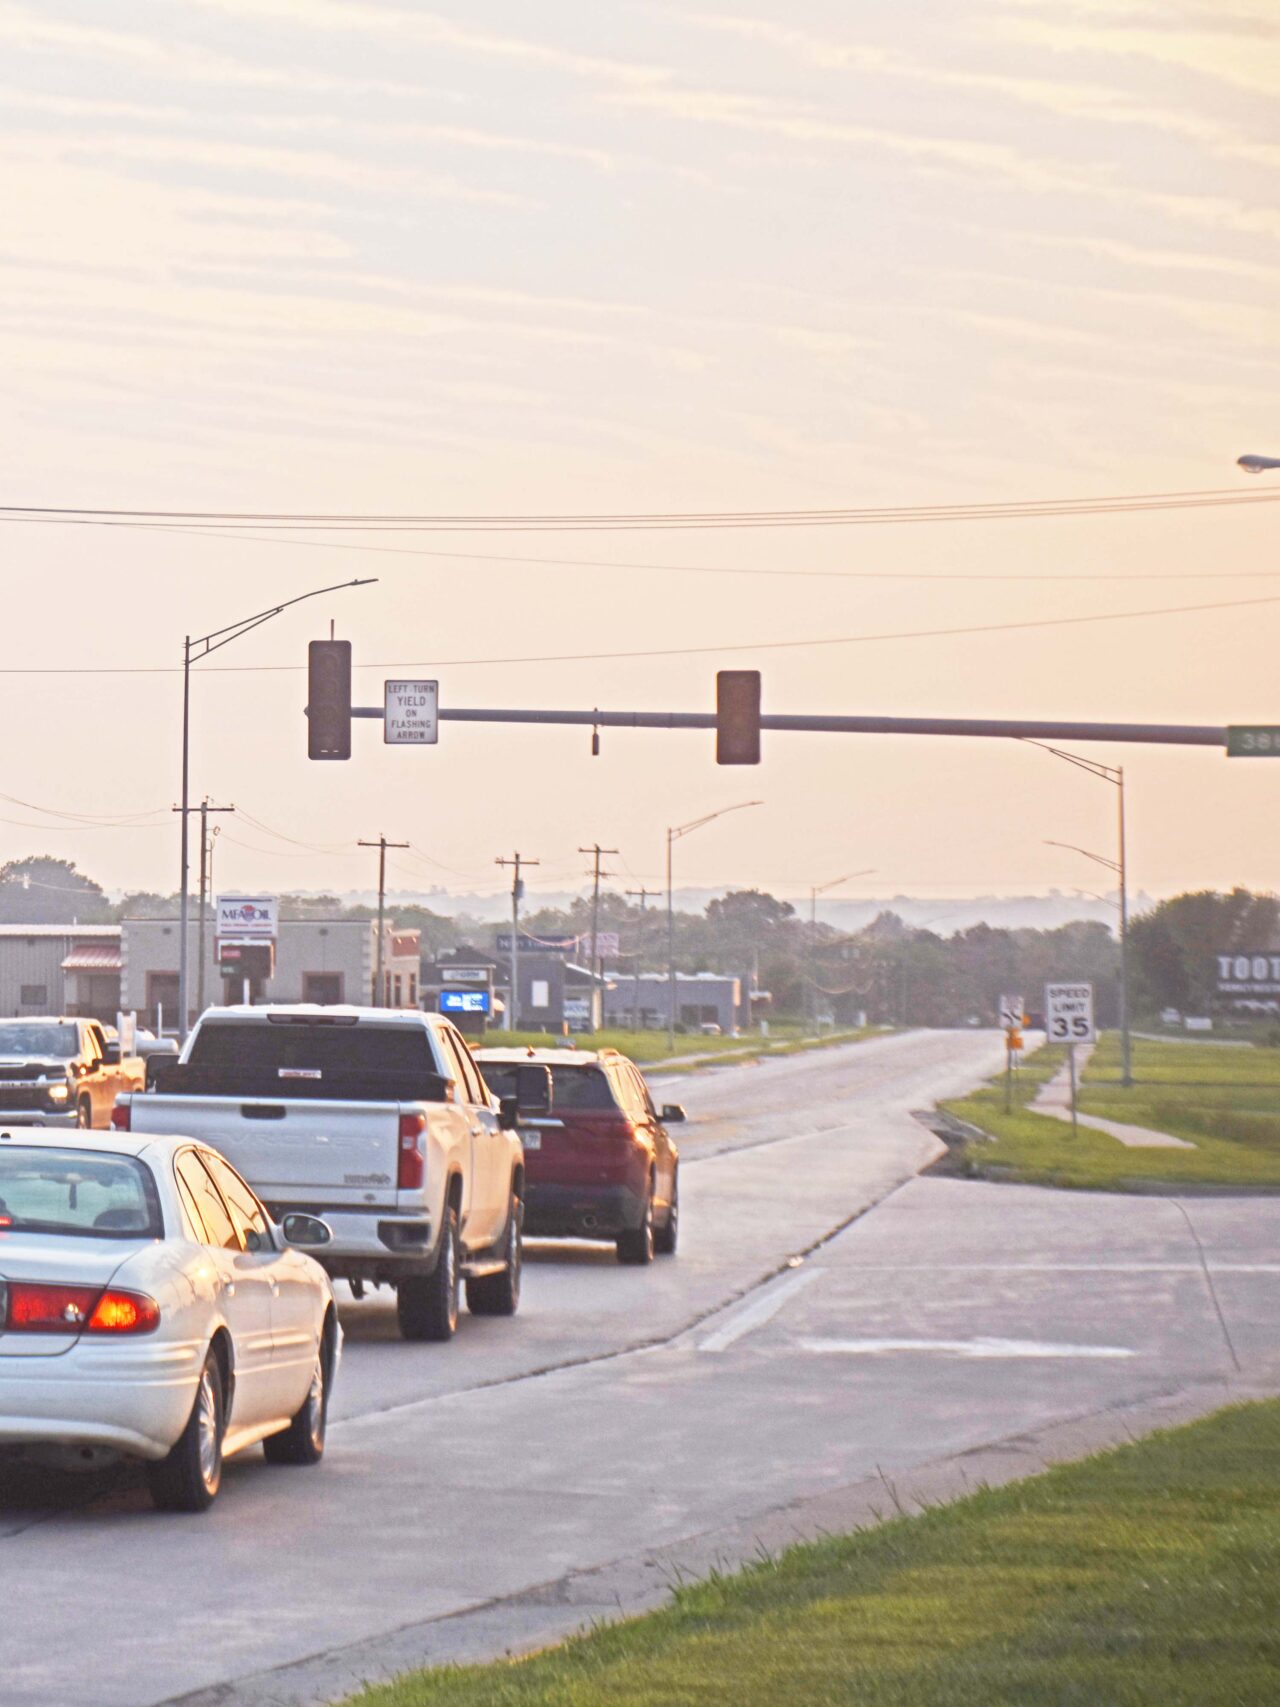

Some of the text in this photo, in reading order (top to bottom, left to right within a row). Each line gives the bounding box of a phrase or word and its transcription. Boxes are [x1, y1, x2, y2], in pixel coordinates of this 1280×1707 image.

[388, 685, 435, 693] LEFT TURN
[397, 696, 426, 706] YIELD
[405, 709, 417, 718] ON
[391, 720, 431, 728] FLASHING
[397, 731, 425, 739] ARROW
[253, 909, 271, 920] OIL
[1217, 955, 1280, 980] TOOT
[1049, 987, 1090, 998] SPEED
[1053, 1003, 1086, 1013] LIMIT
[1053, 1017, 1090, 1038] 35
